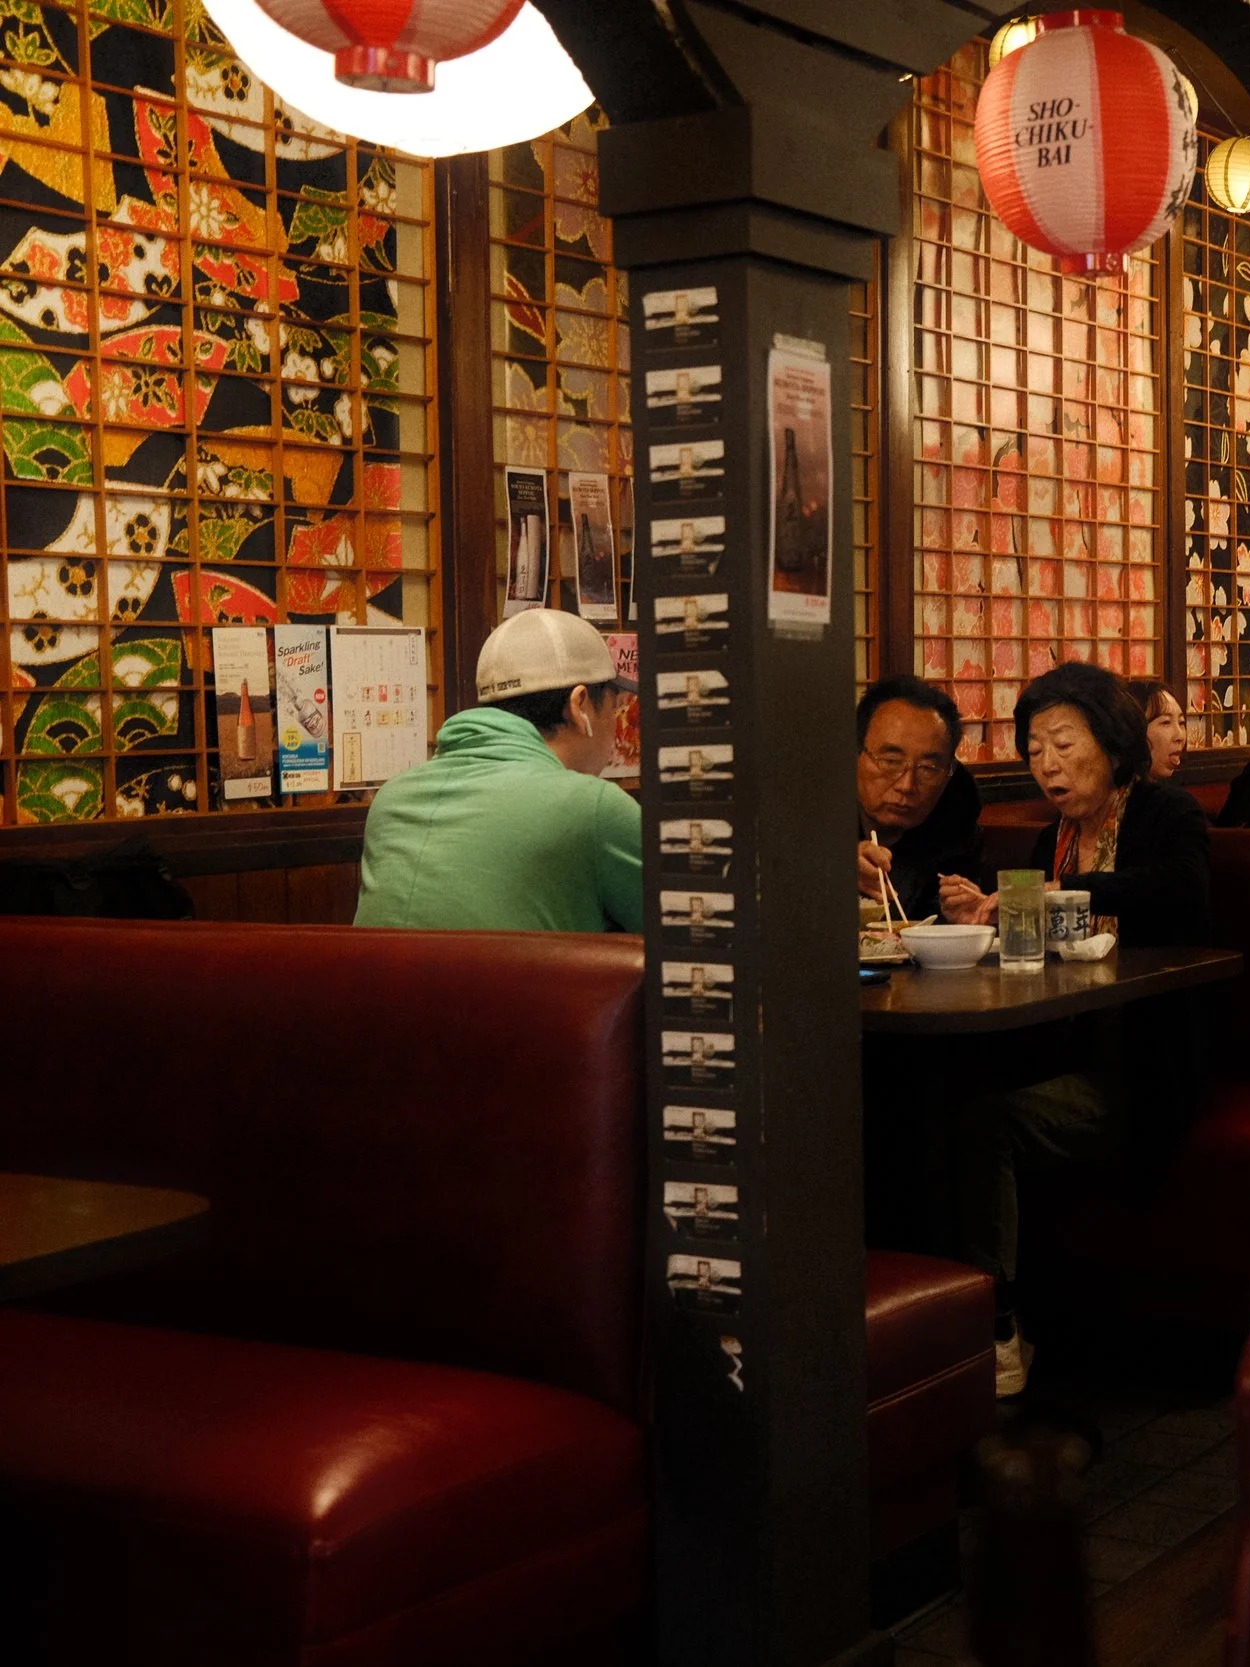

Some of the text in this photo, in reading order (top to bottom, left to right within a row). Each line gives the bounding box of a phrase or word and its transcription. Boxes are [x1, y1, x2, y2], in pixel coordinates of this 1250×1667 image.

[1027, 98, 1080, 122] SHO-
[1015, 119, 1094, 148] CHIKU-
[1037, 145, 1072, 168] BAI
[278, 641, 321, 657] Sparkling
[299, 662, 324, 676] Sake!
